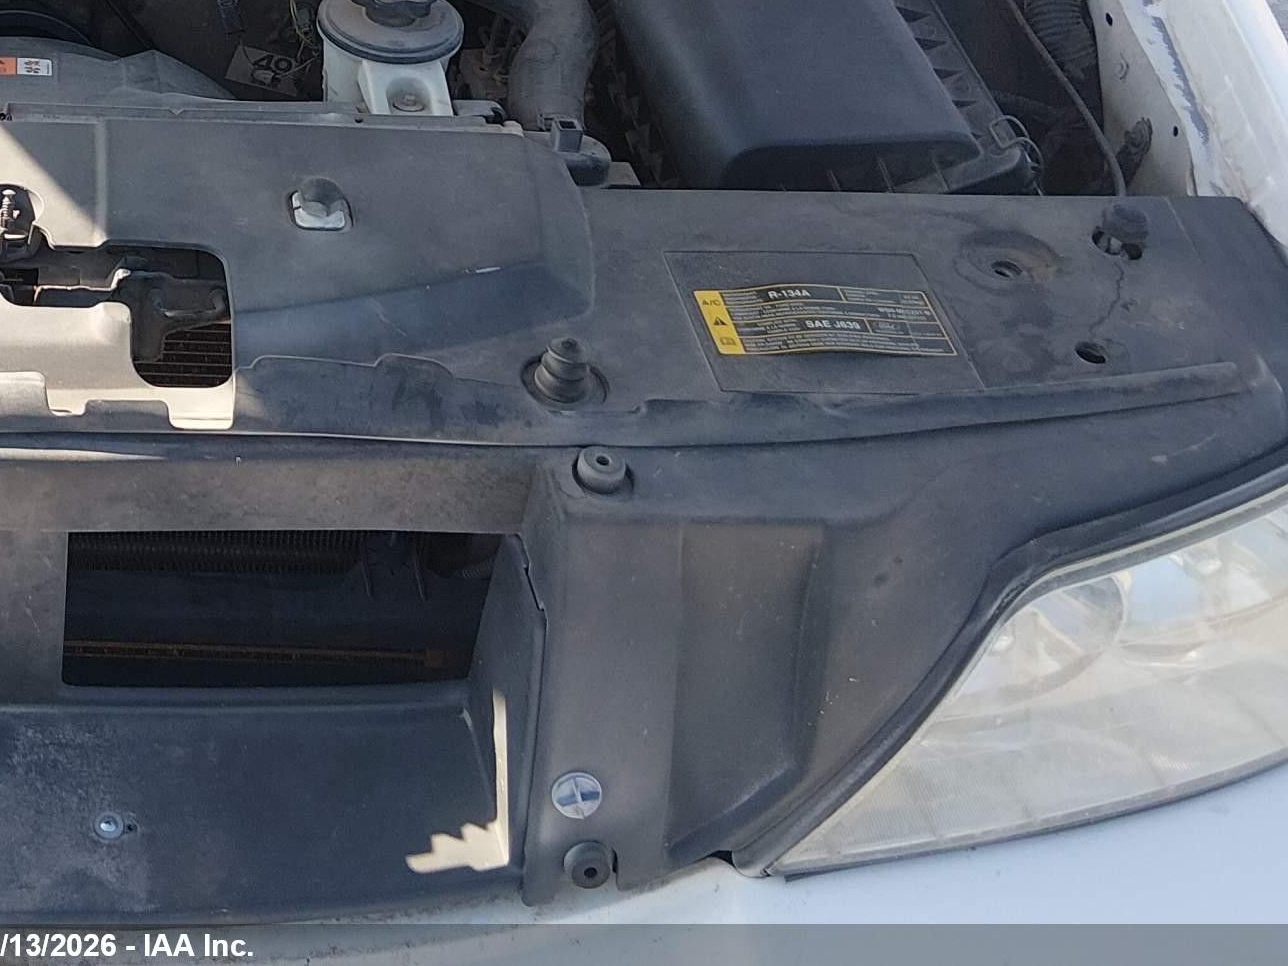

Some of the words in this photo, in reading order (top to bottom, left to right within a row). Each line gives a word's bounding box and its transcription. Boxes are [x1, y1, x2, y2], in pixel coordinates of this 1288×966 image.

[767, 289, 811, 300] R-134A
[805, 320, 832, 328] SAE
[833, 320, 861, 330] J639
